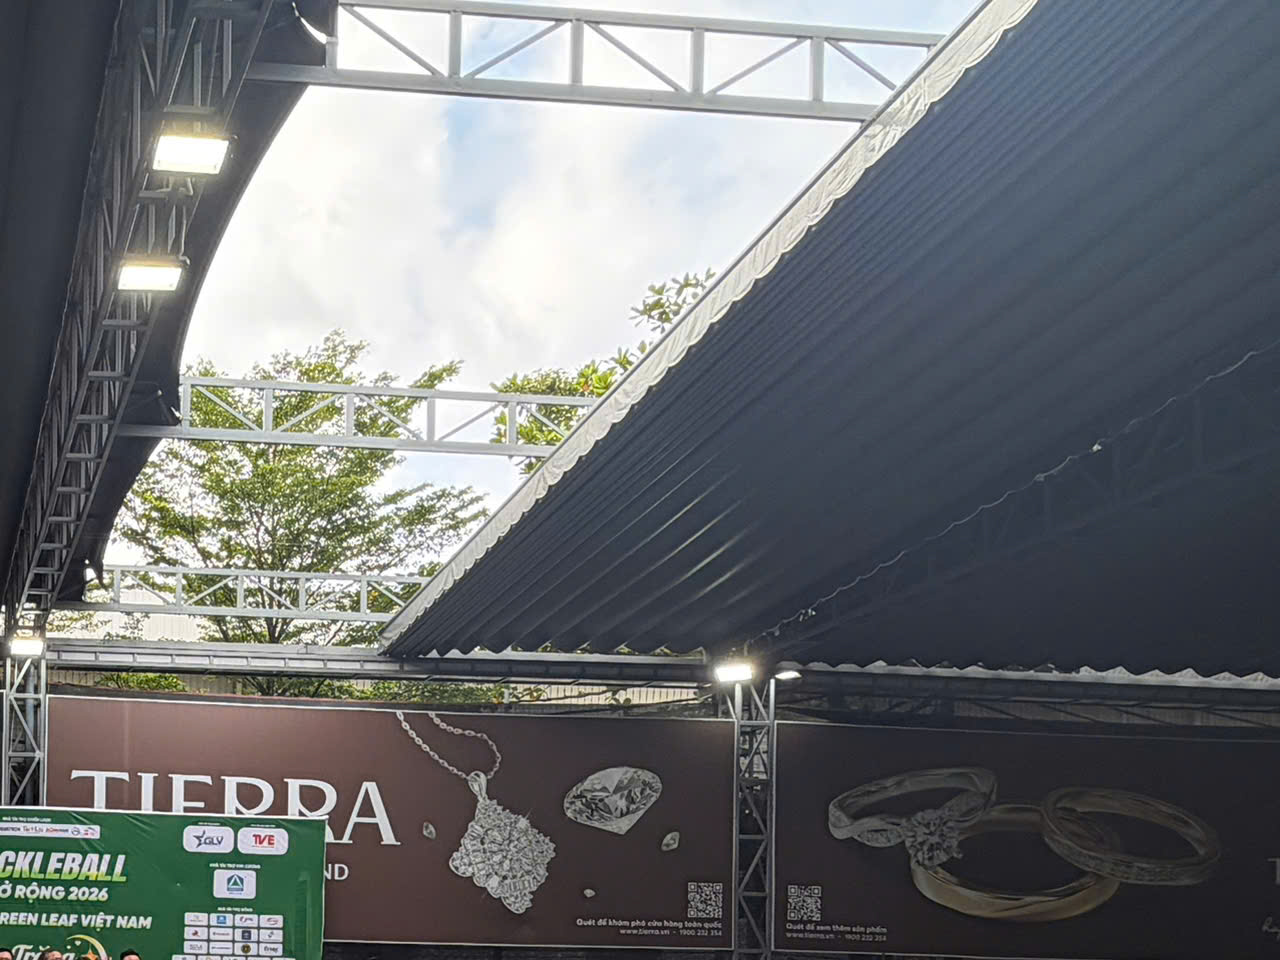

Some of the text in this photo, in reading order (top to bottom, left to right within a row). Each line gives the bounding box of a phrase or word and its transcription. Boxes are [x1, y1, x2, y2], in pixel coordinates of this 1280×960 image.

[14, 881, 66, 903] RỘNG
[67, 886, 109, 901] 2026
[41, 913, 79, 928] LEAF
[81, 912, 114, 932] VIỆT
[116, 916, 153, 930] NAM
